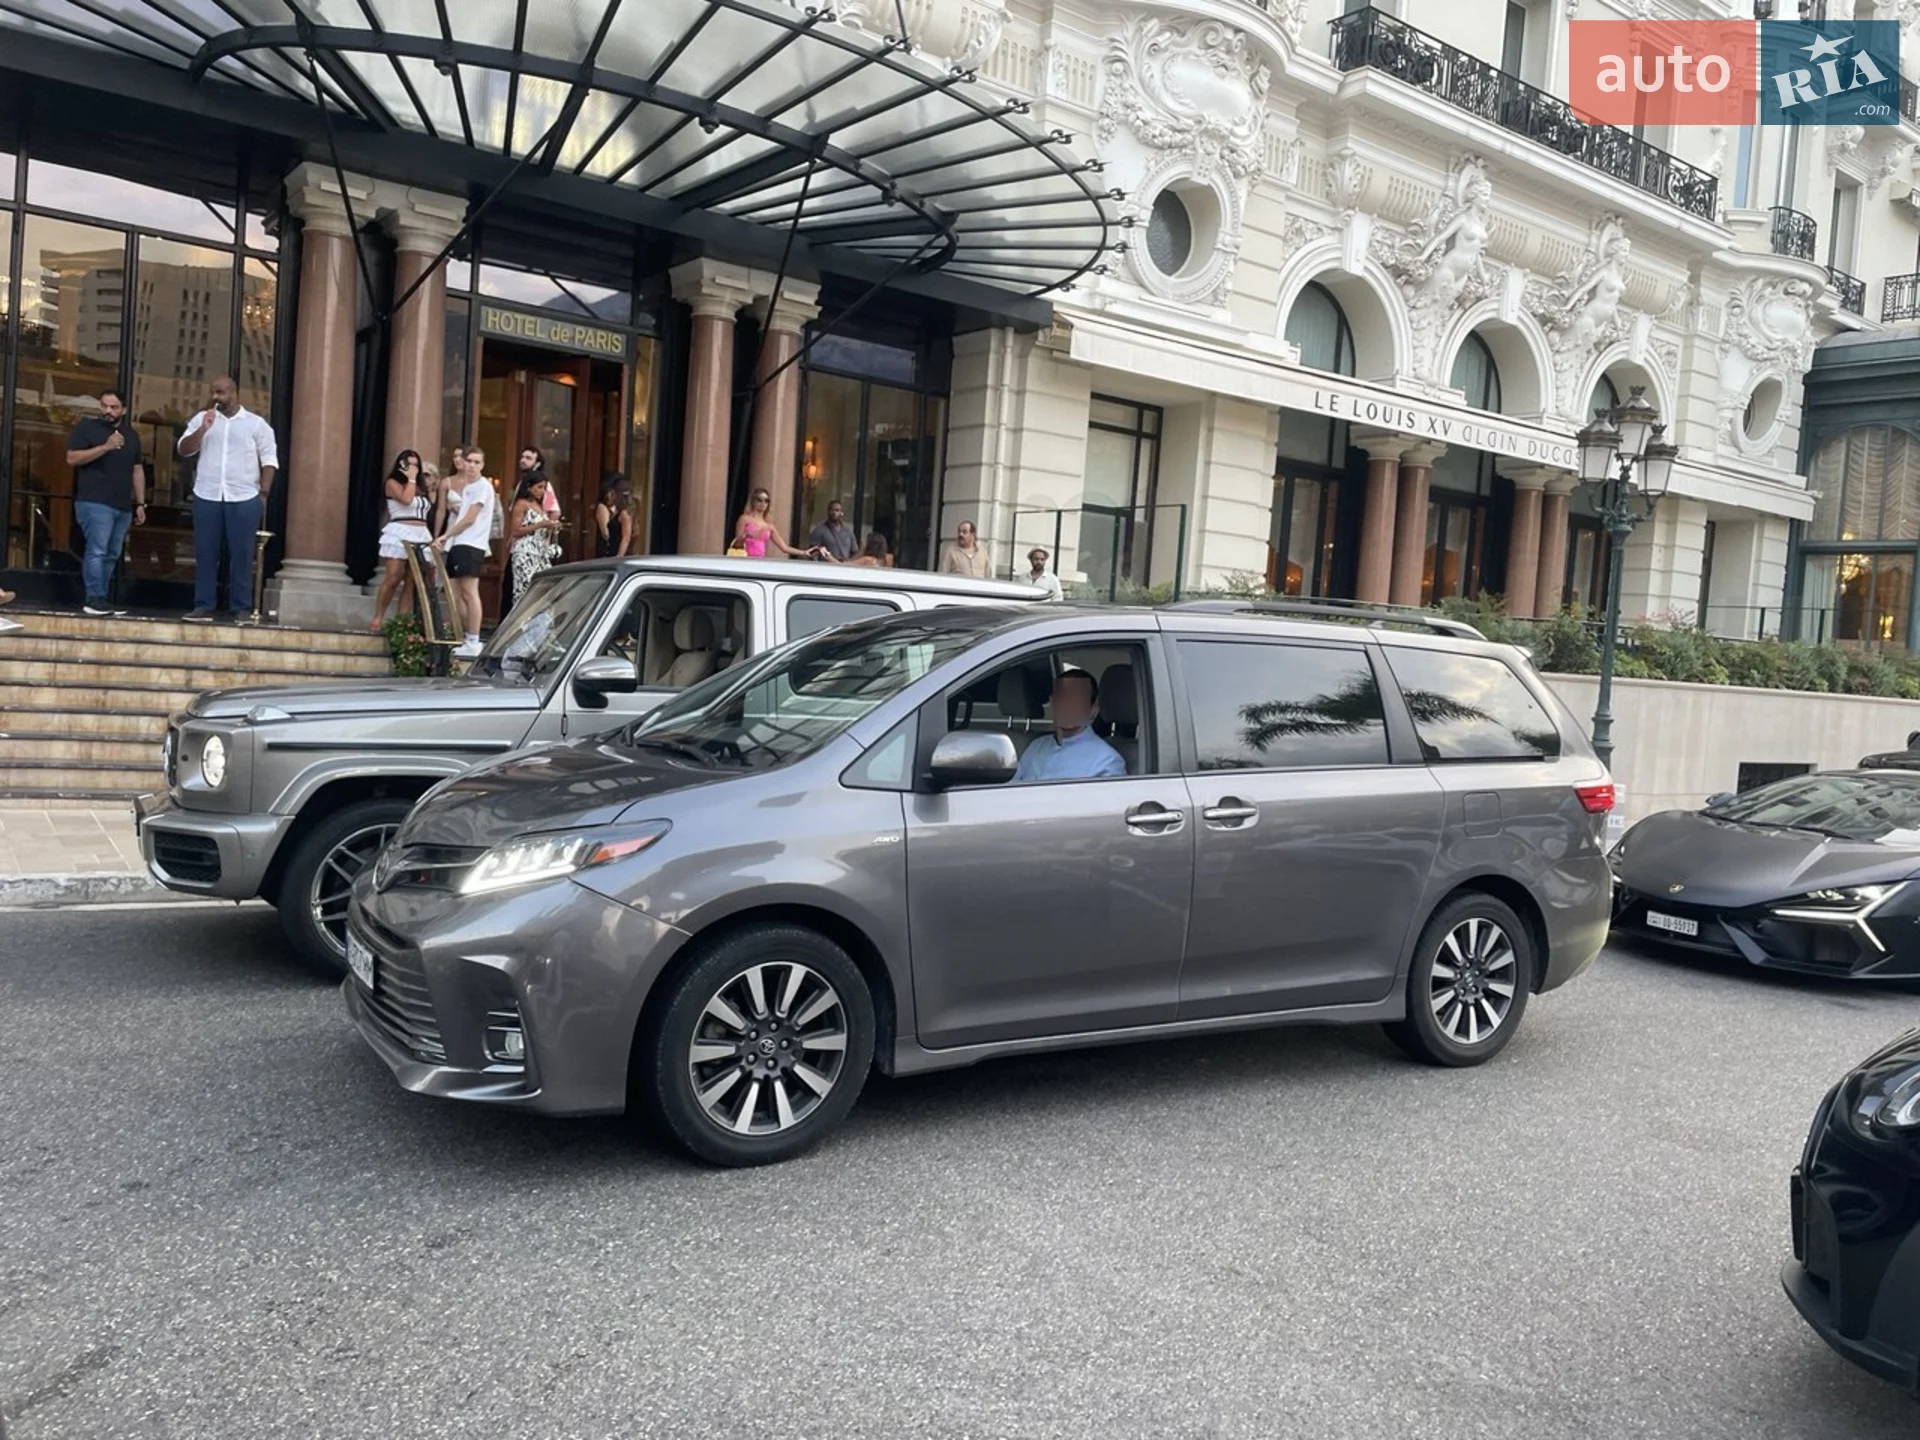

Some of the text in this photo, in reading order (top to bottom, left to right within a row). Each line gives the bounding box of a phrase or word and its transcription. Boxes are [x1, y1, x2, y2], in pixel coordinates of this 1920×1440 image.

[486, 309, 623, 354] HOTEL de PARIS
[1314, 390, 1339, 413] LE
[1353, 399, 1415, 429] LOUIS
[1427, 416, 1452, 436] XV
